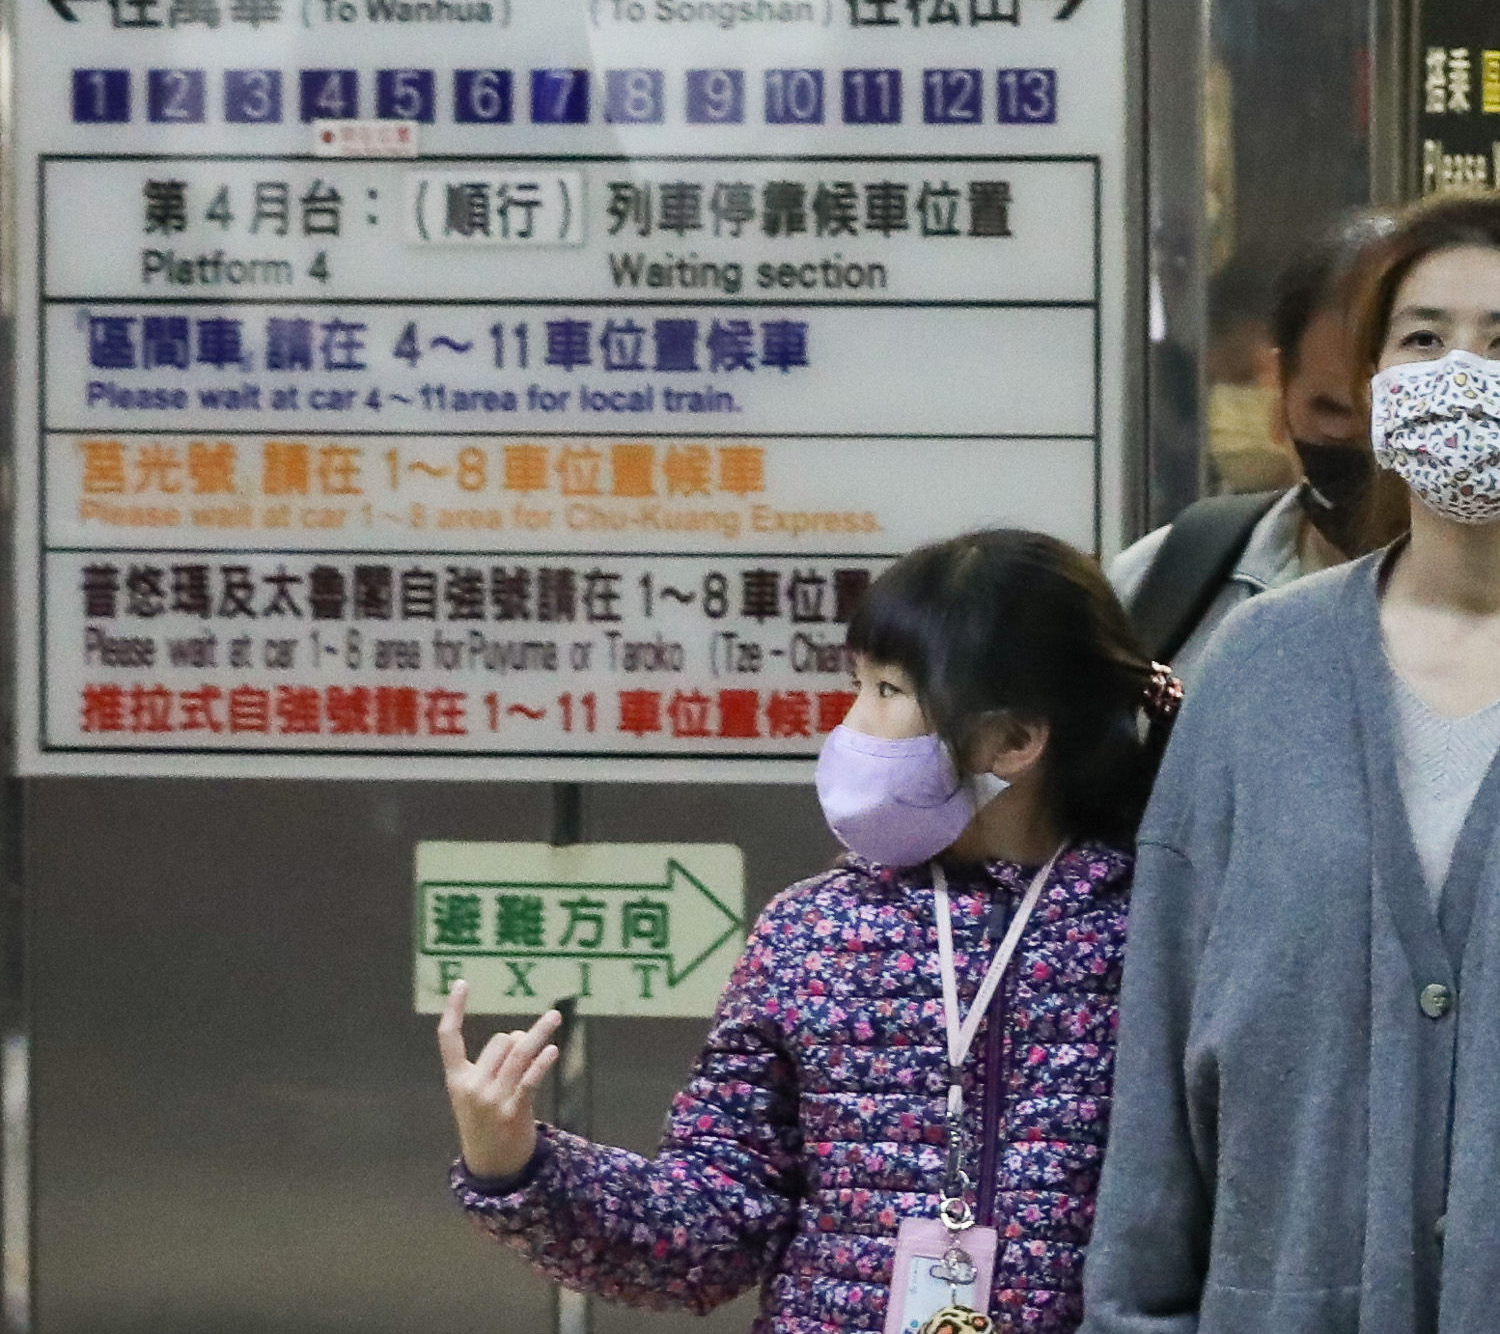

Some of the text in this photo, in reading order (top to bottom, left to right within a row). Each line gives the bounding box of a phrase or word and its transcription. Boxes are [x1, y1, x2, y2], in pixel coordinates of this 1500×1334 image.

[91, 70, 1051, 119] 1 2 3 4 5 6 7 8 9 10 11 12 13
[142, 249, 332, 286] Platform 4
[608, 251, 889, 294] Waiting section
[86, 380, 189, 410] Please
[200, 382, 261, 411] wait
[271, 384, 299, 412] at
[309, 387, 356, 411] car
[525, 384, 571, 413] for
[579, 382, 654, 413] local
[663, 385, 743, 414] train.
[432, 892, 670, 949] 避難方向
